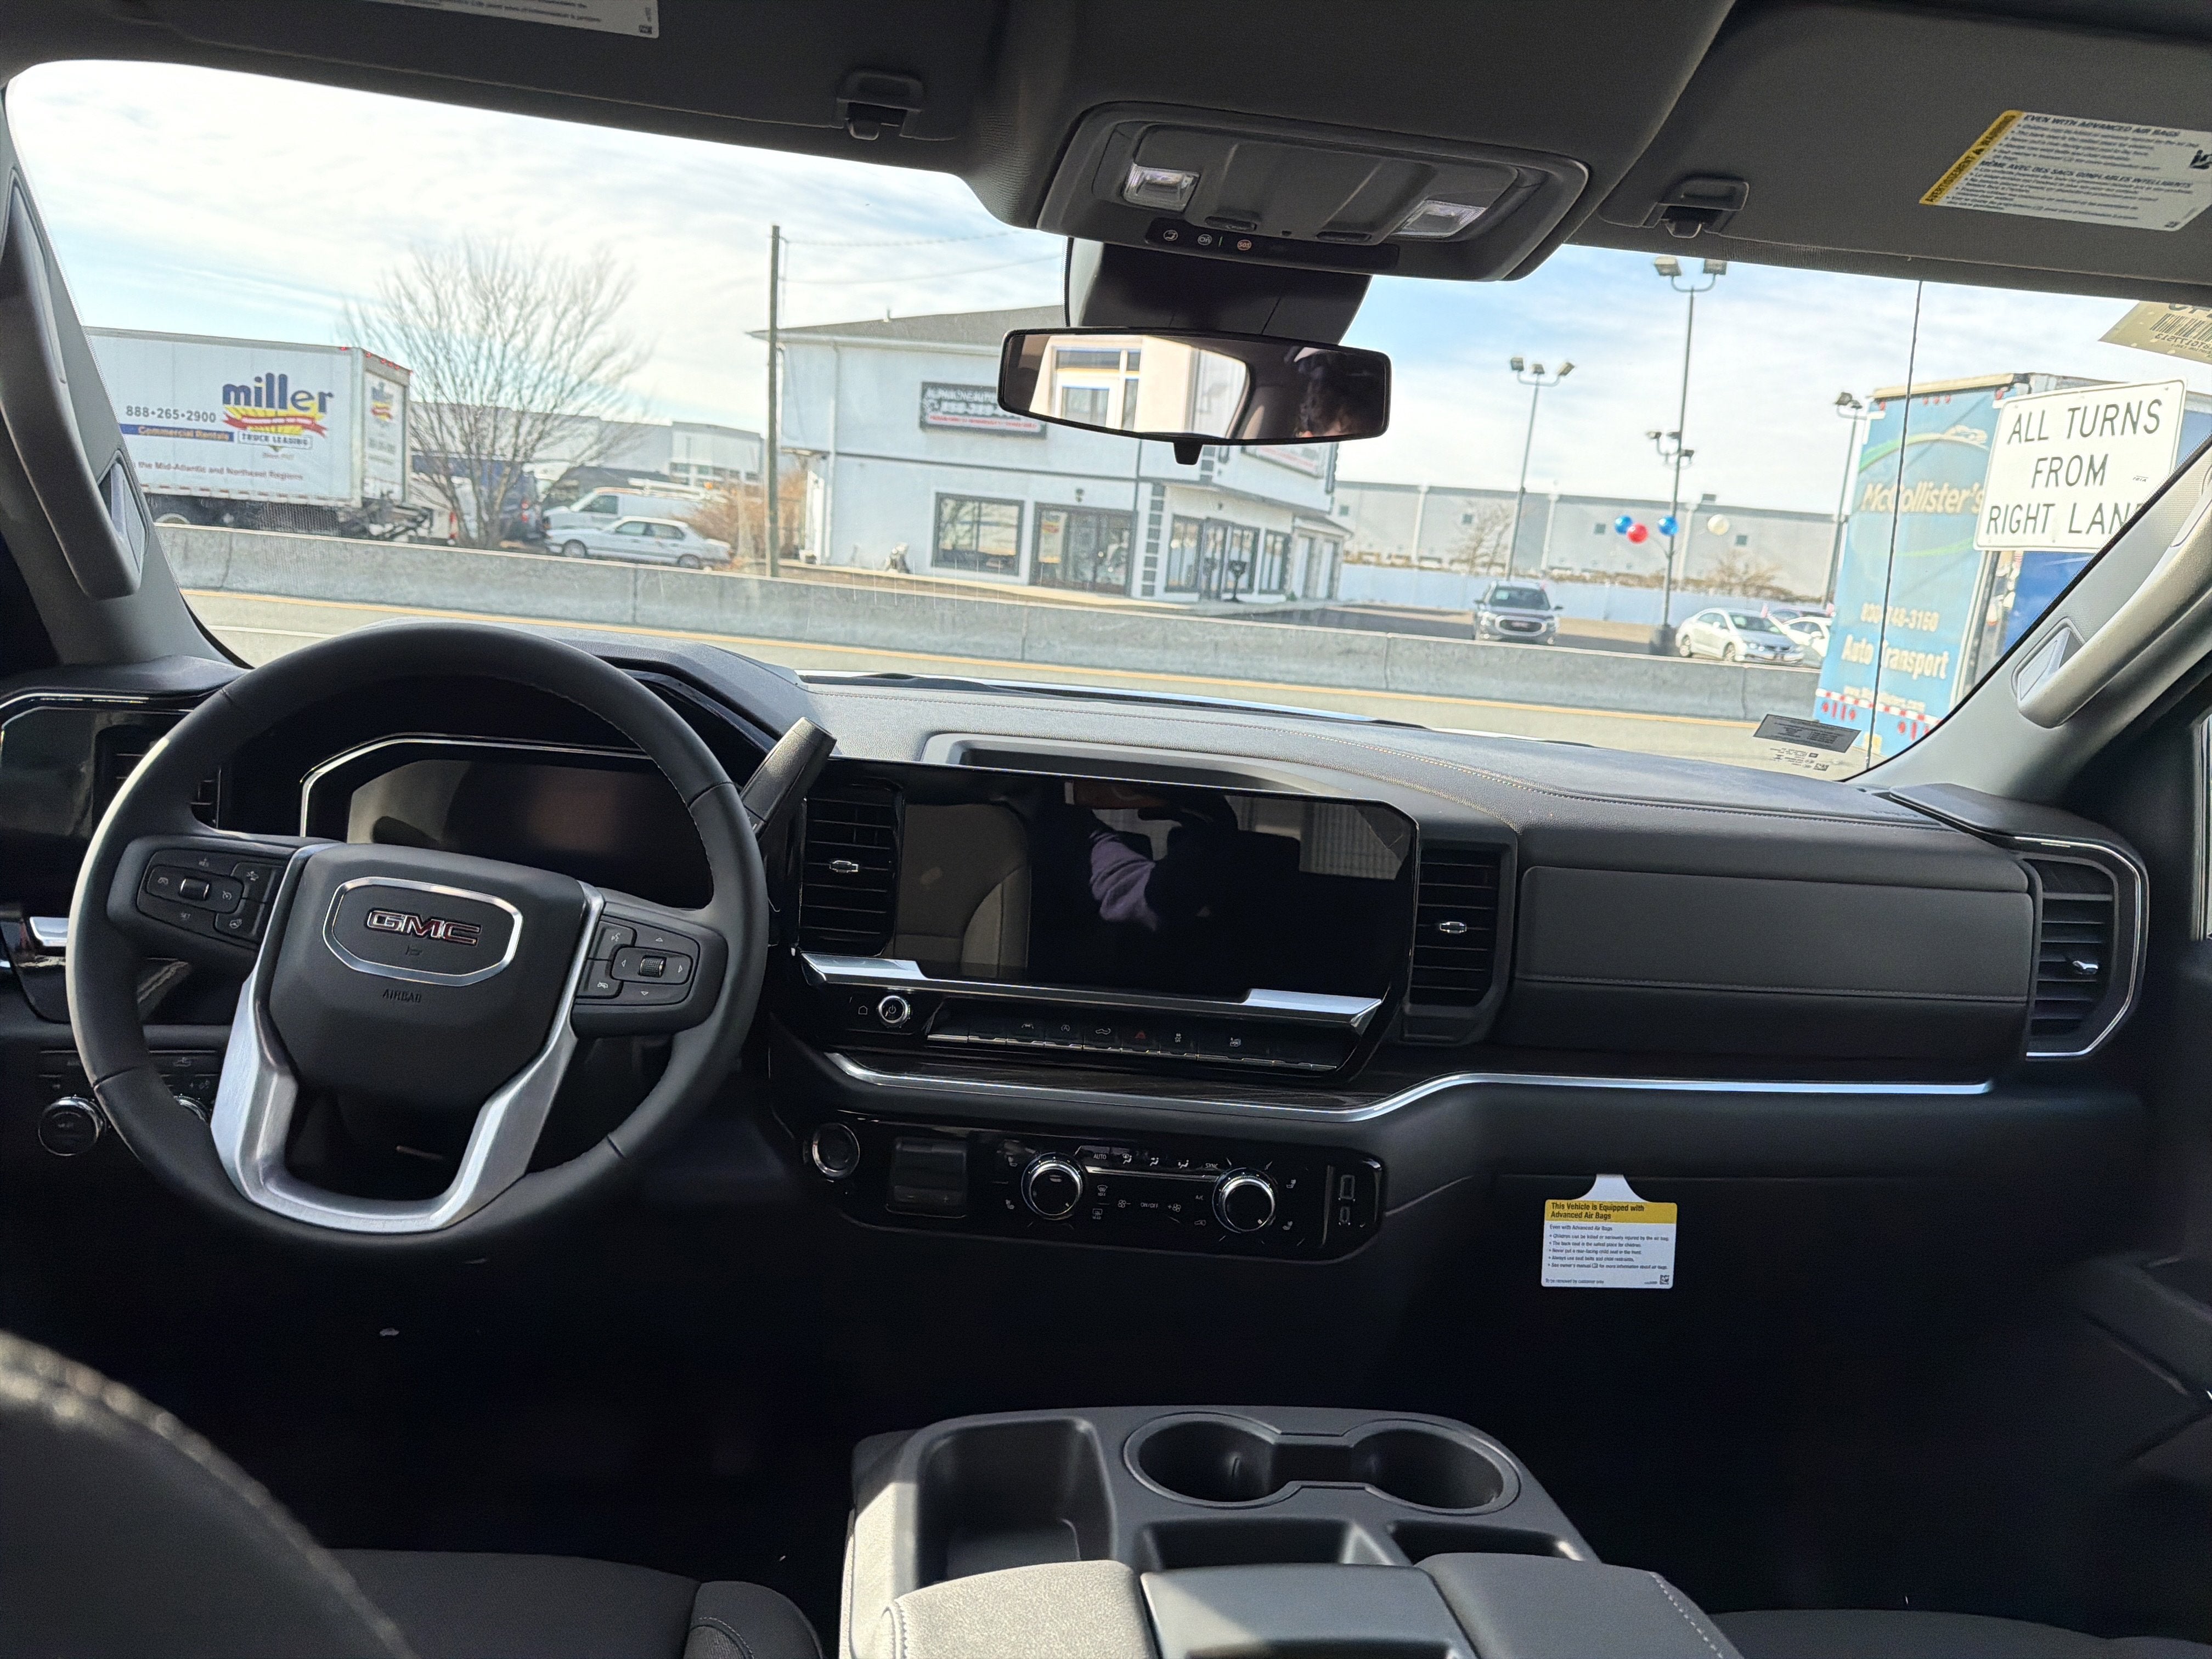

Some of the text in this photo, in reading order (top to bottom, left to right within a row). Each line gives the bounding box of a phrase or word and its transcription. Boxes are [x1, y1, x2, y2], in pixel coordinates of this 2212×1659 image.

[2052, 117, 2078, 126] WITH
[222, 373, 334, 413] miller
[2007, 399, 2162, 445] ALL TURNS
[226, 468, 267, 478] Northeast
[268, 471, 303, 481] Regions
[2032, 454, 2109, 489] FROM
[1860, 481, 1985, 515] McCollister's
[1987, 502, 2141, 535] RIGHT LAN
[1841, 634, 1874, 665] Auto
[366, 909, 481, 947] GMC
[382, 989, 422, 1004] AIRBAG
[1595, 1212, 1611, 1220] Bags
[1599, 1203, 1629, 1212] Equipped
